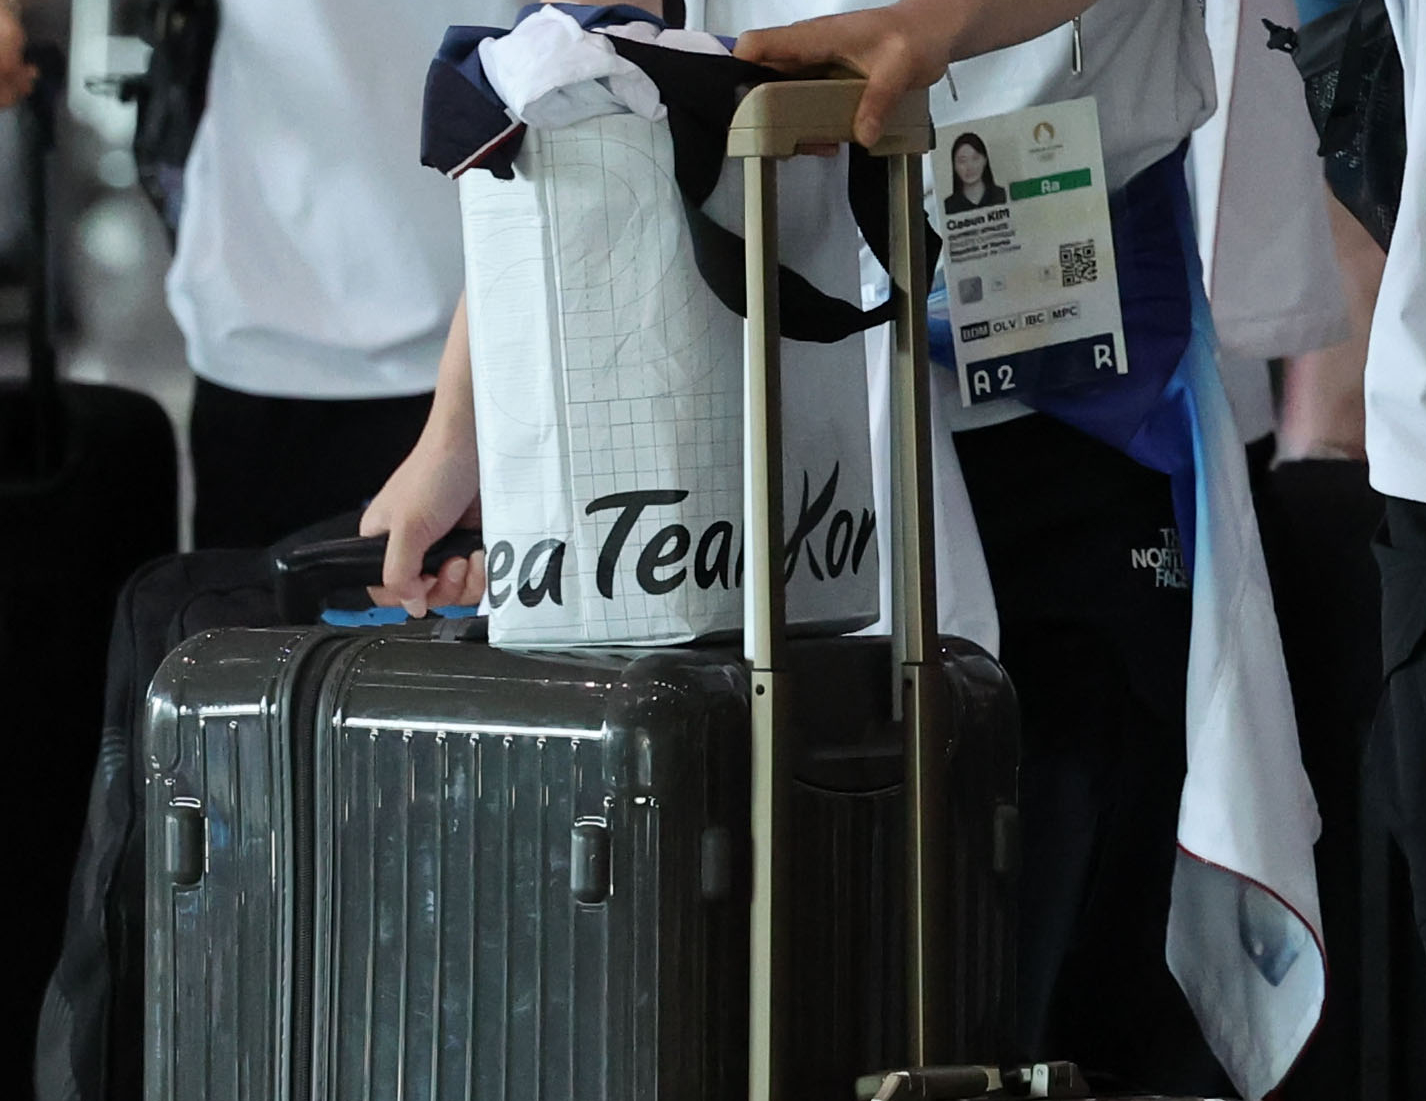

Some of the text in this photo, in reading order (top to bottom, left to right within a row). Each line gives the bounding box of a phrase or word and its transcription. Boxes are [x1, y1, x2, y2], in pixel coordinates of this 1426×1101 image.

[986, 208, 1010, 222] KIM
[993, 319, 1017, 333] OLV
[1025, 312, 1045, 326] IBC
[1052, 305, 1078, 319] MPC
[973, 344, 1113, 396] A 2 R
[486, 538, 566, 609] ea
